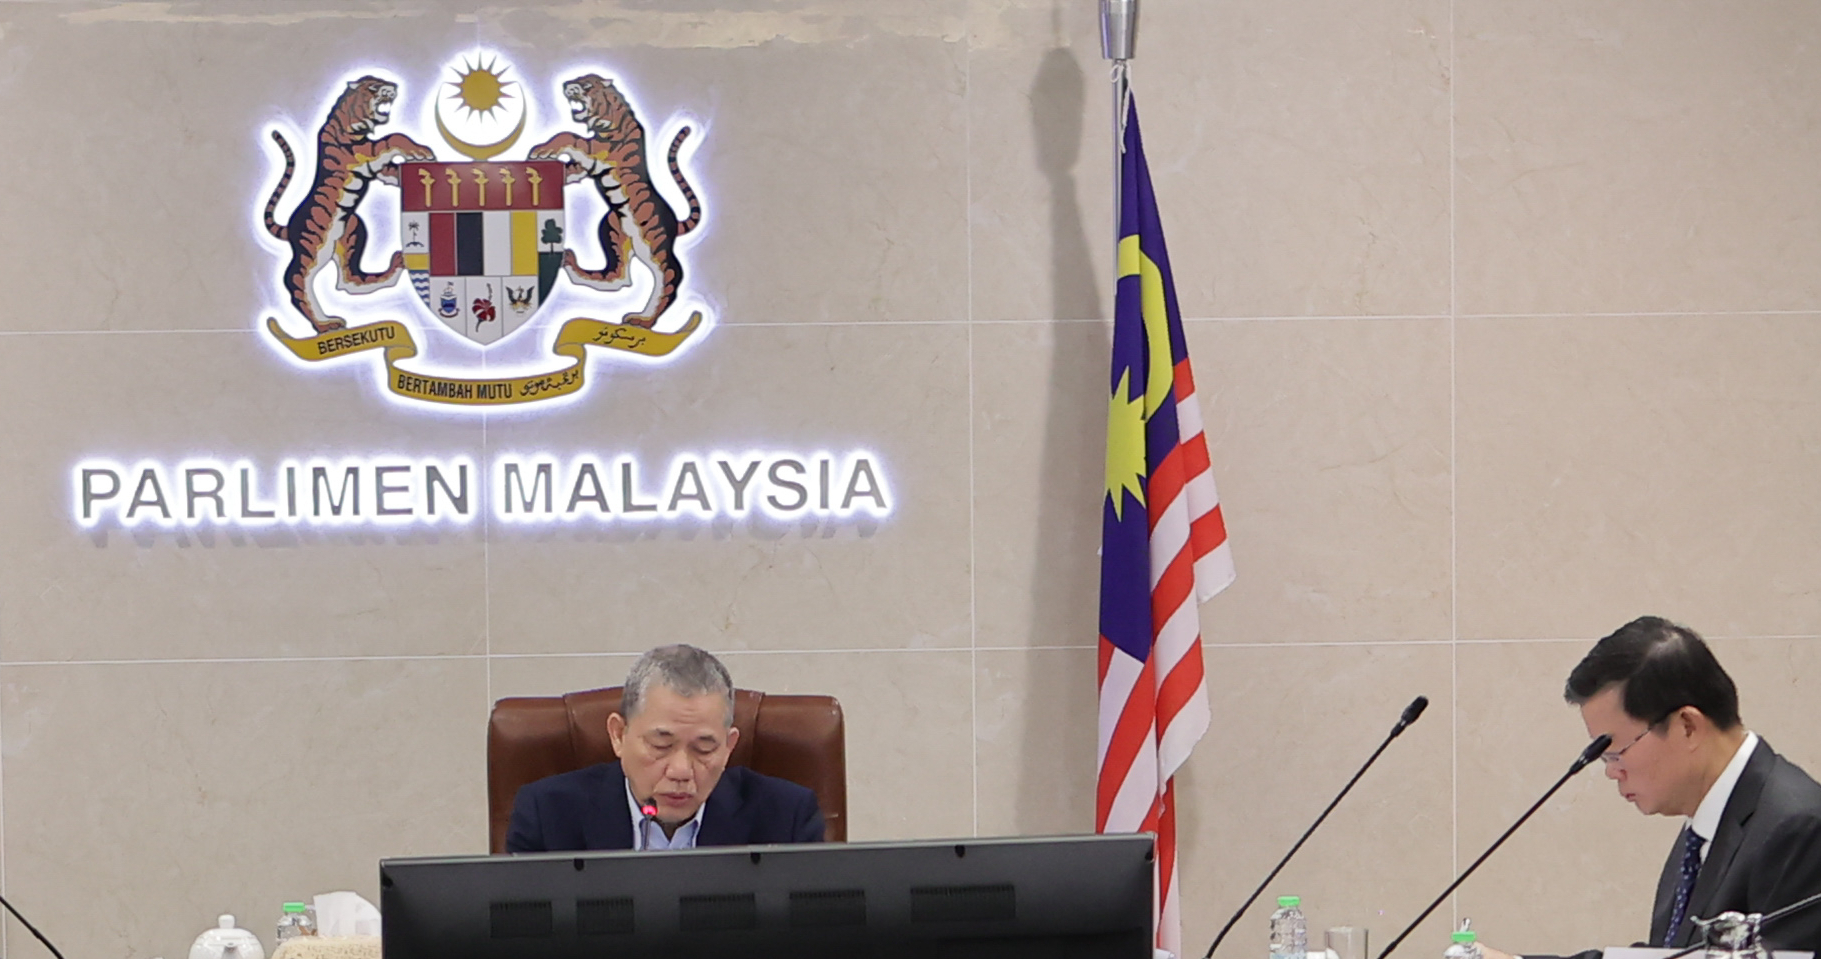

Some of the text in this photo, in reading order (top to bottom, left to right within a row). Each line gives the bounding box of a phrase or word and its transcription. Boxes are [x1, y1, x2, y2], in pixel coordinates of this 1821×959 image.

[317, 326, 396, 355] BERSEKUTU
[397, 374, 513, 400] BERTAMBAH MUTU
[81, 458, 889, 519] PARLIMEN MALAYSIA
